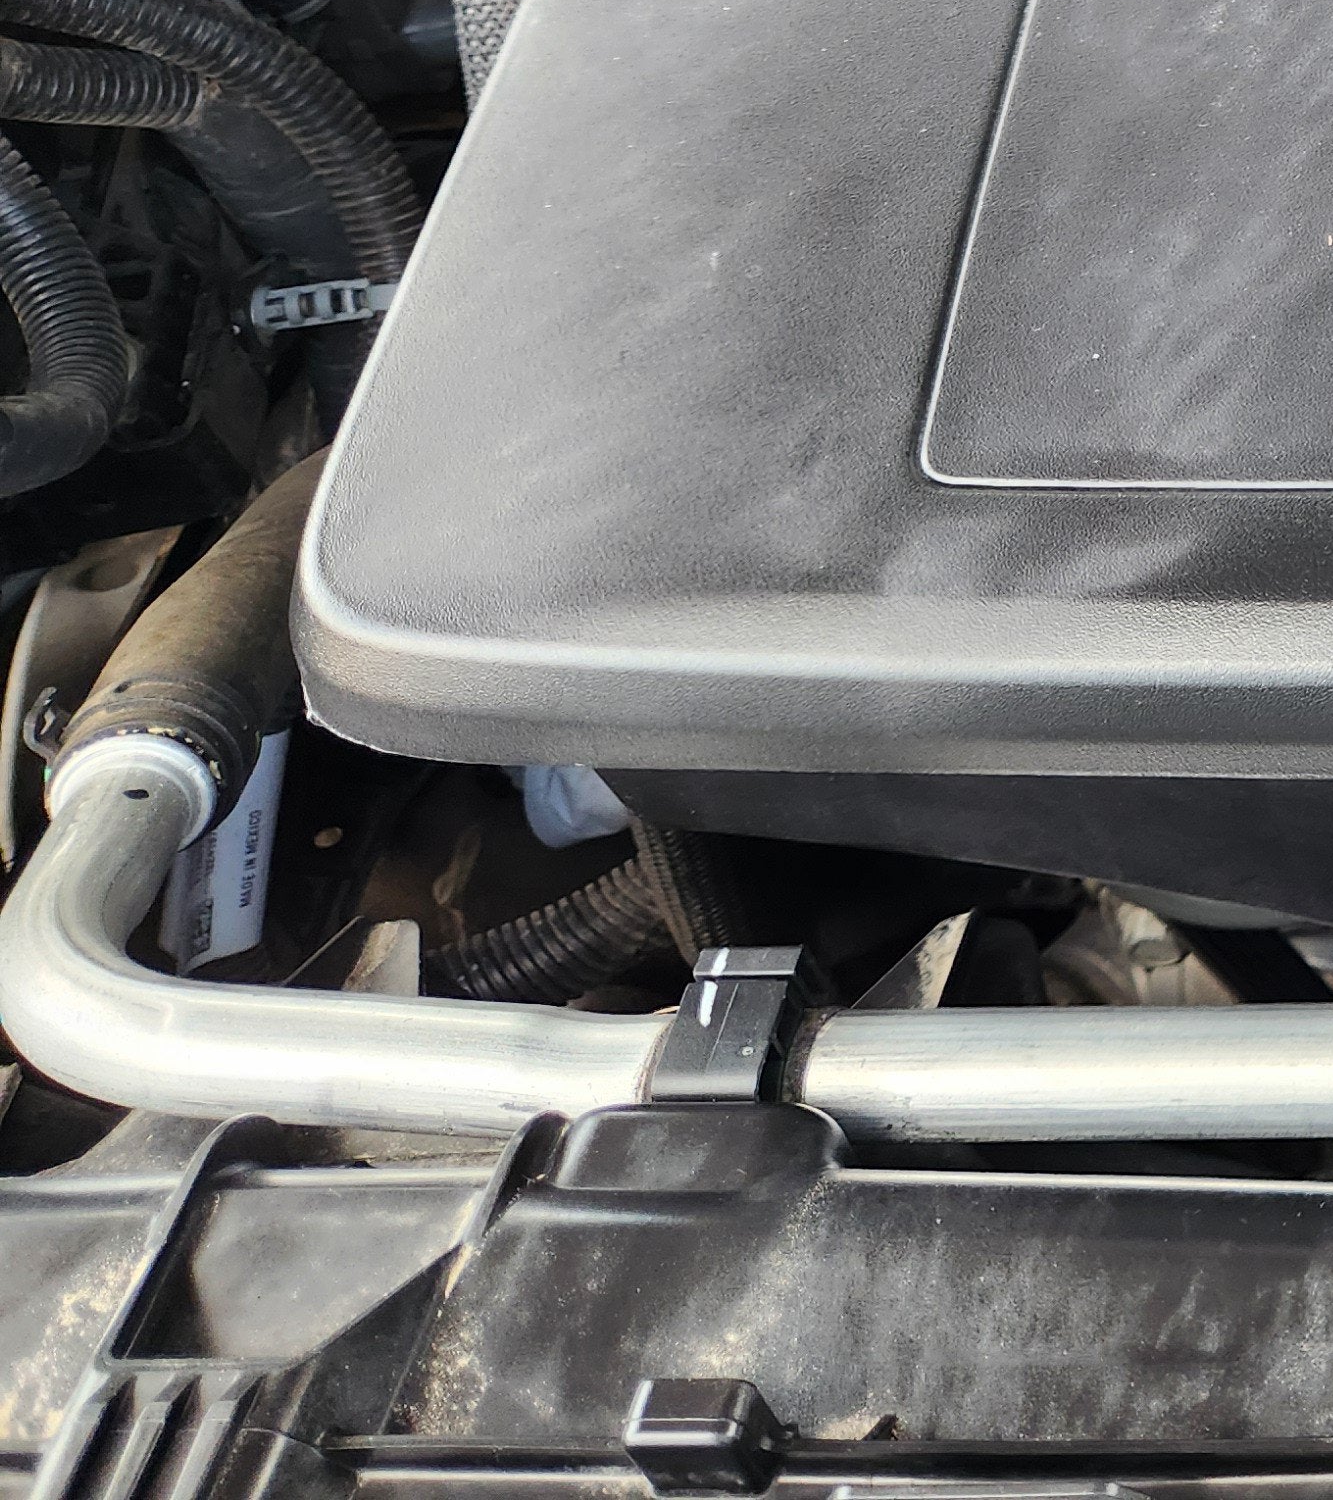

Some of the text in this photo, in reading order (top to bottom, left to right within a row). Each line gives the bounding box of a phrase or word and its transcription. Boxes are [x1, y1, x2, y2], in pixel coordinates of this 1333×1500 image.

[239, 809, 262, 908] MADE IN MEXICO
